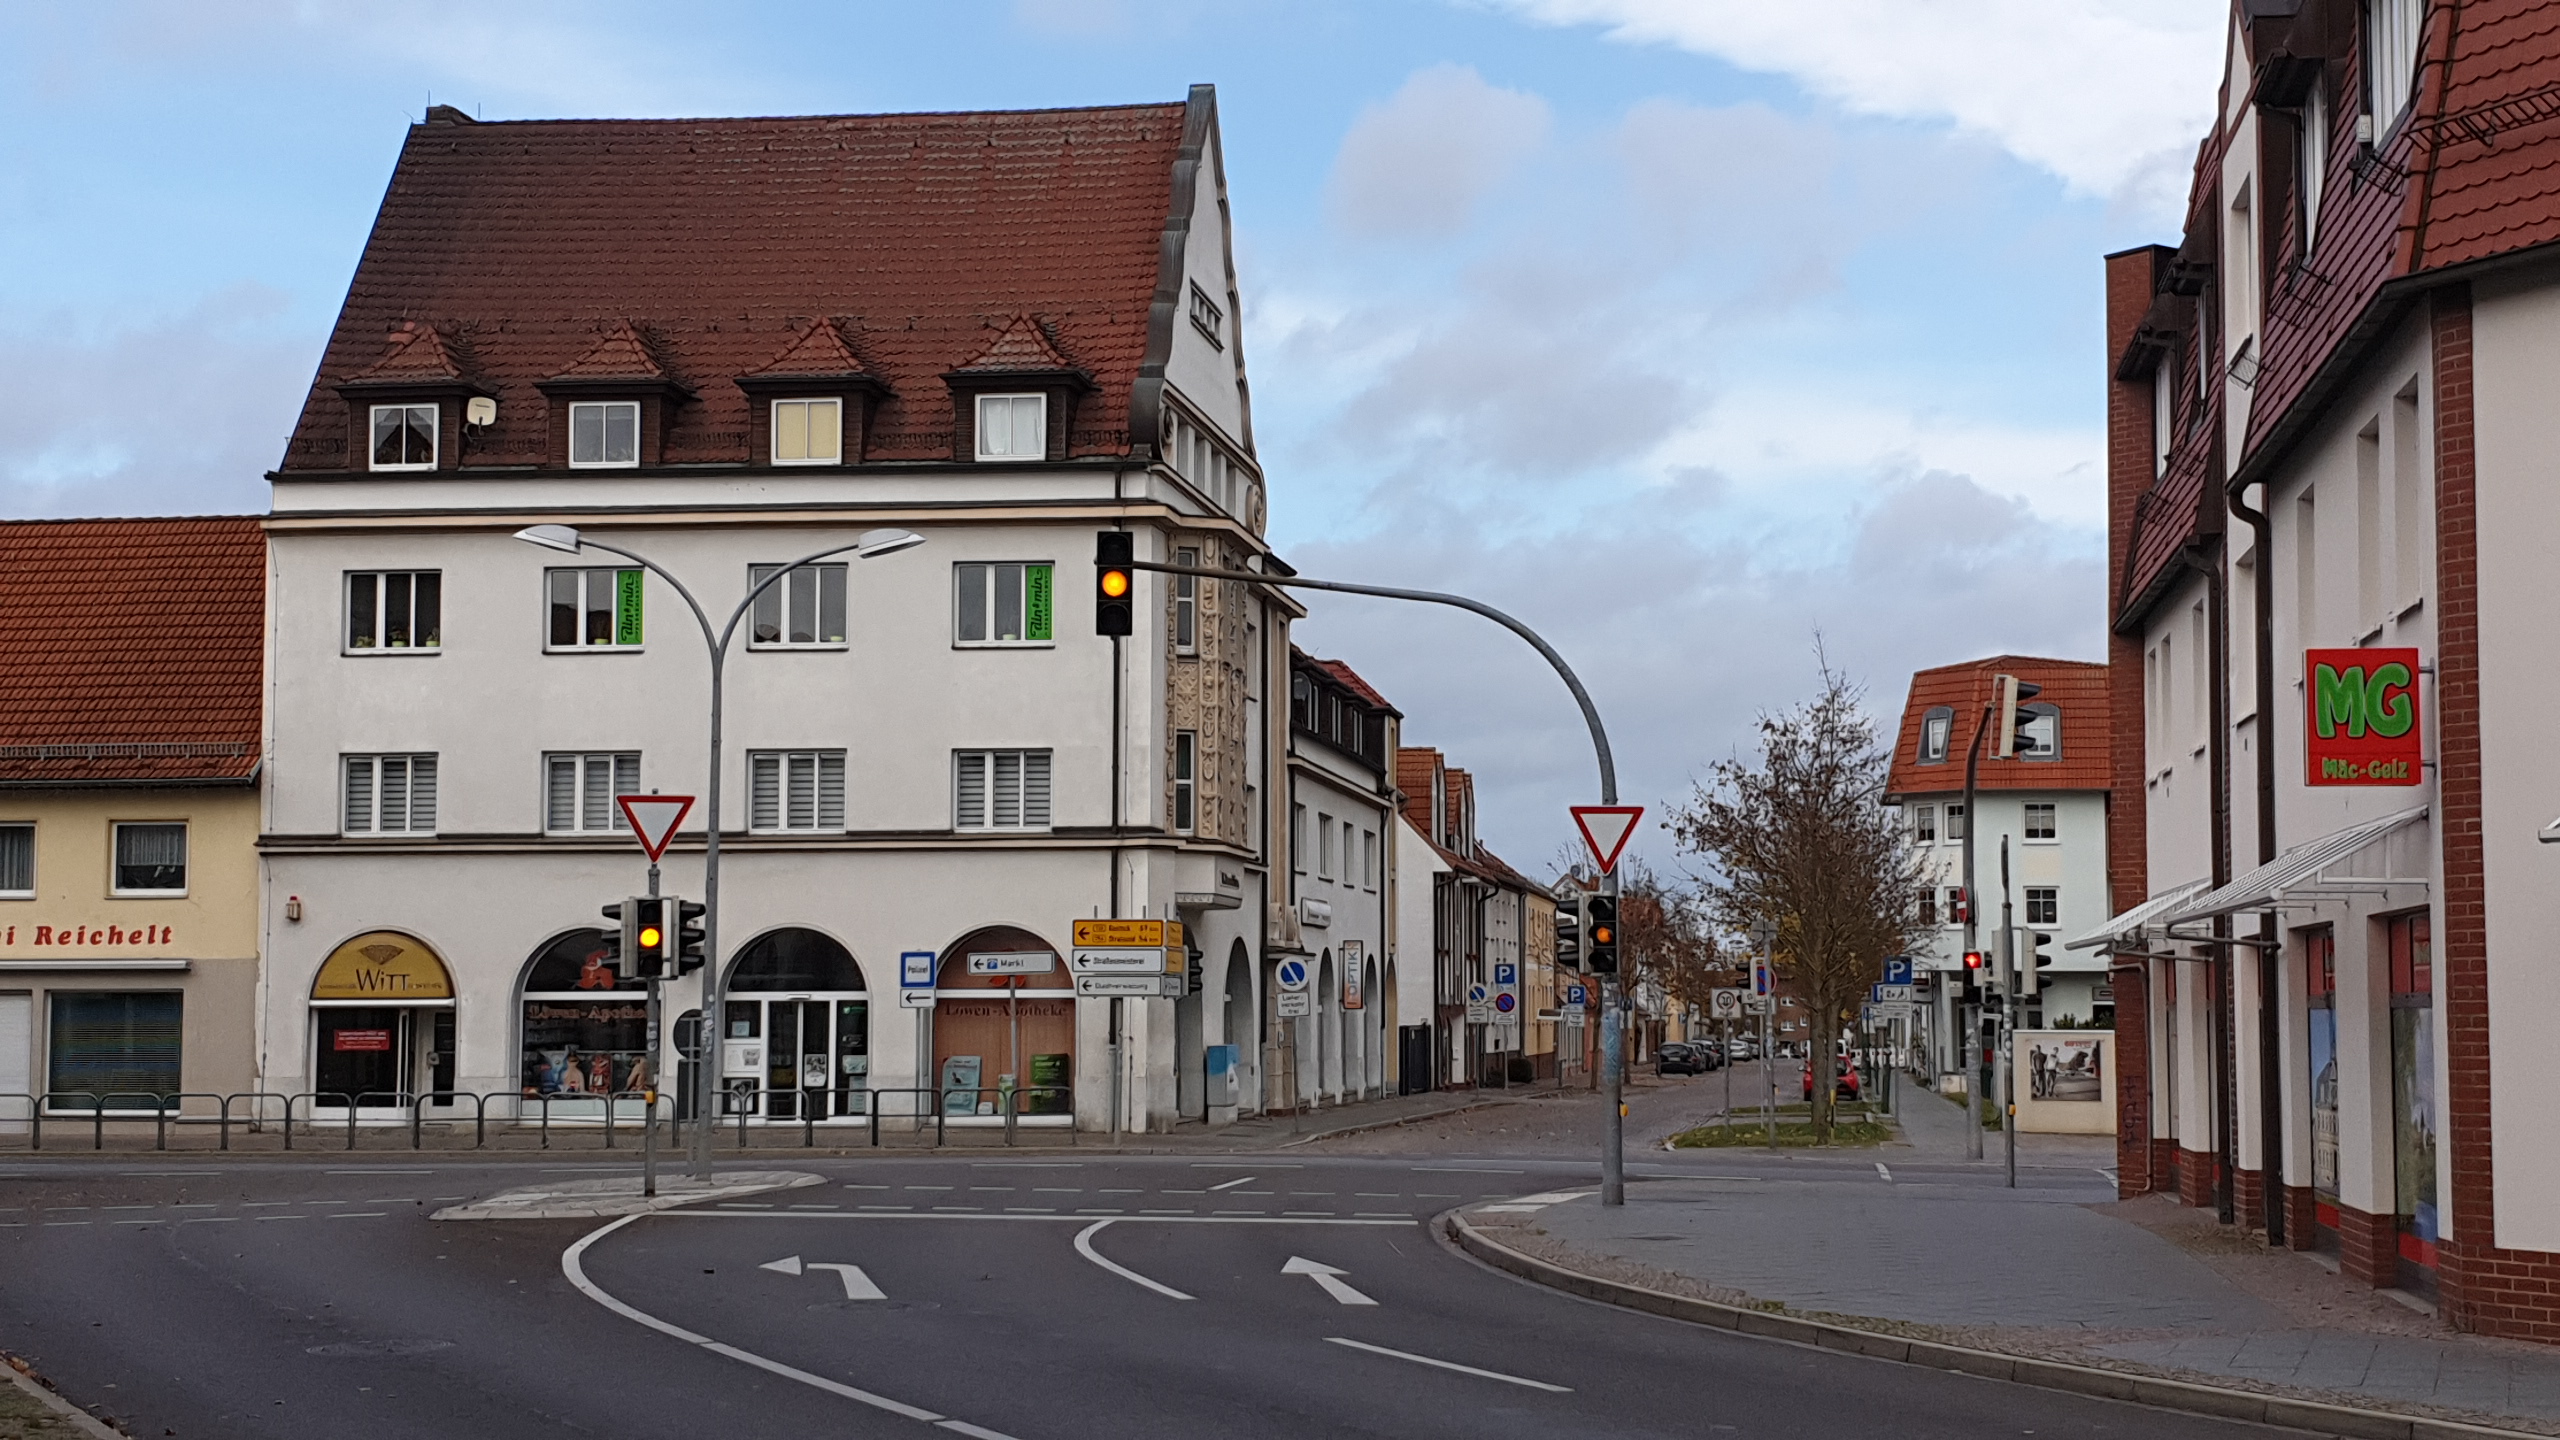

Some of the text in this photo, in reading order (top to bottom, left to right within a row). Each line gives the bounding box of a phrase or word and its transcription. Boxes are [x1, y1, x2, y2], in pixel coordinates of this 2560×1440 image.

[2315, 662, 2413, 738] MG
[34, 924, 172, 945] Reichelt
[1001, 960, 1024, 968] Markt
